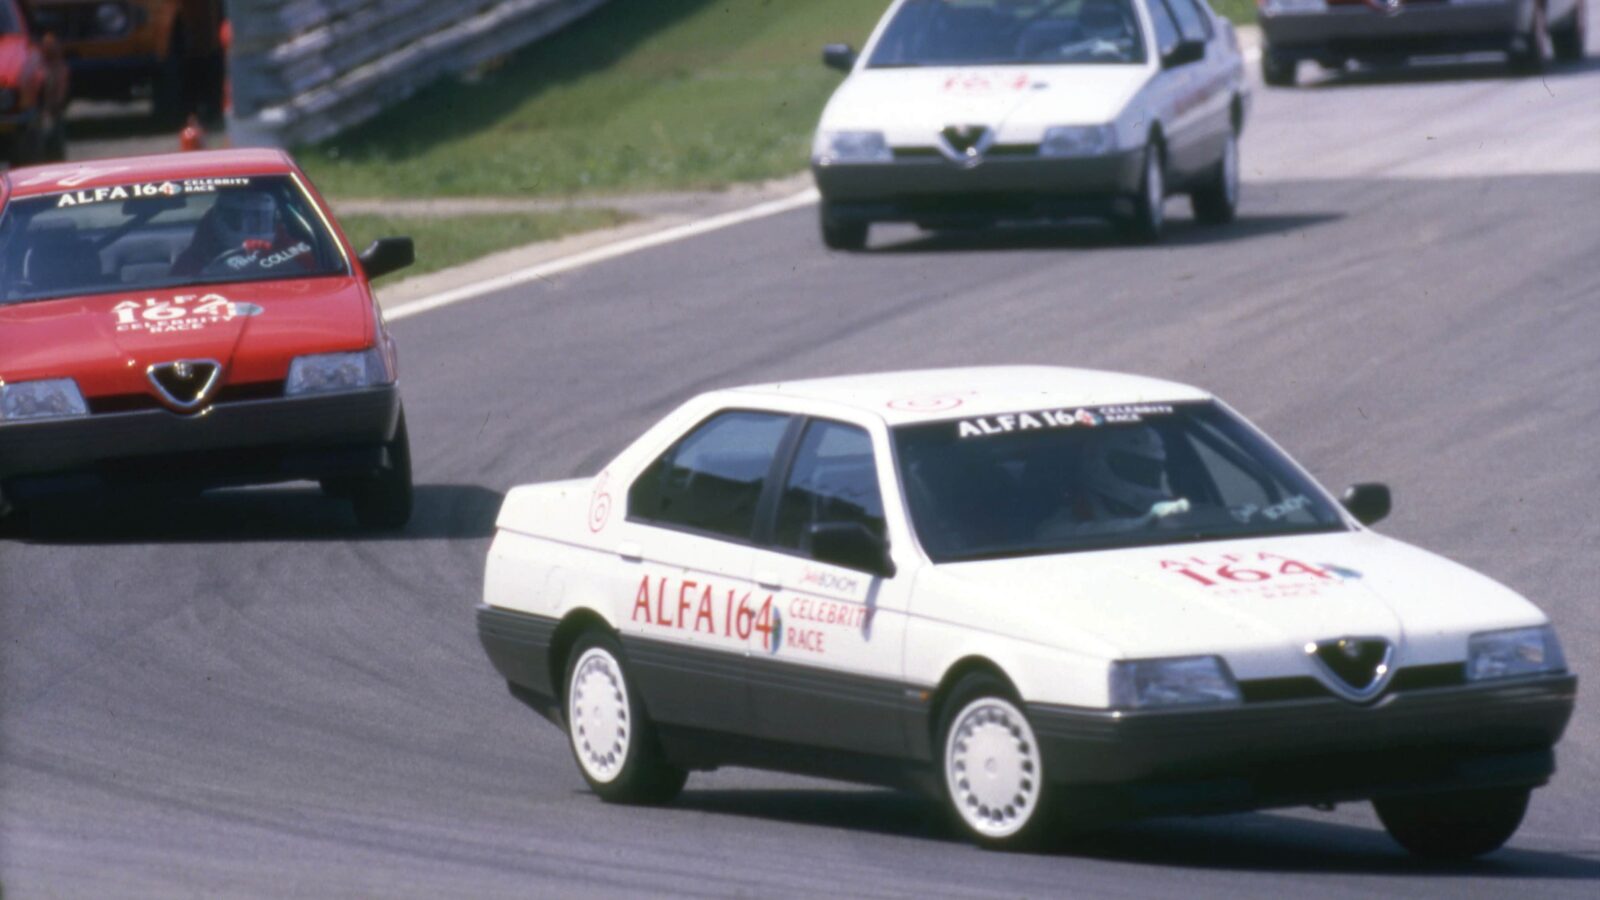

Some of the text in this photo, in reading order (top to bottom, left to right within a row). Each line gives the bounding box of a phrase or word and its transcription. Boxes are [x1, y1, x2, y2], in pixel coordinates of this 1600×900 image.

[57, 181, 175, 207] ALFA 164
[183, 178, 250, 186] CELEBRITY
[184, 185, 215, 193] RACE
[111, 293, 229, 312] ALFA
[114, 300, 238, 324] 164
[957, 407, 1102, 438] ALFA 164
[1100, 405, 1174, 415] CELEBRITY
[1105, 412, 1143, 423] RACE
[1174, 558, 1334, 587] 164
[631, 575, 774, 650] ALFA 164
[788, 596, 877, 630] CELEBRITY
[787, 626, 825, 653] RACE
